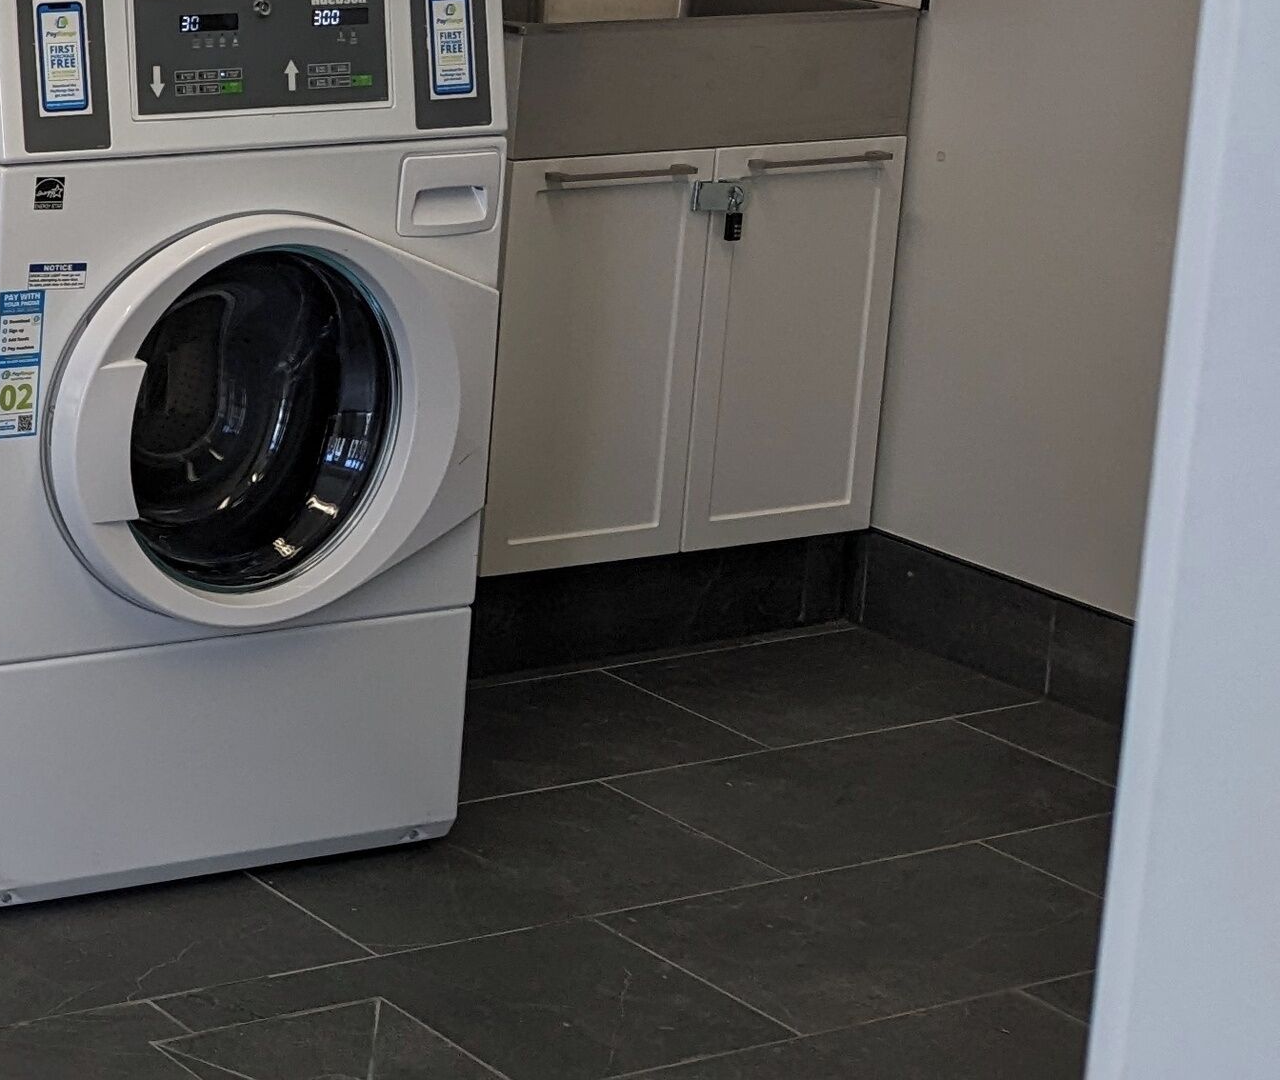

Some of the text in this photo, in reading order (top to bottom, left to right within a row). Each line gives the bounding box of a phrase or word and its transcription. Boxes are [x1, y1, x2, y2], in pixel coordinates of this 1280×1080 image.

[314, 10, 340, 26] 300
[181, 16, 200, 32] 30
[439, 31, 462, 40] FIRST
[49, 45, 75, 54] FIRST
[440, 44, 463, 54] FREE
[50, 58, 76, 69] FREE
[43, 264, 73, 272] NOTICE
[0, 384, 33, 411] 02
